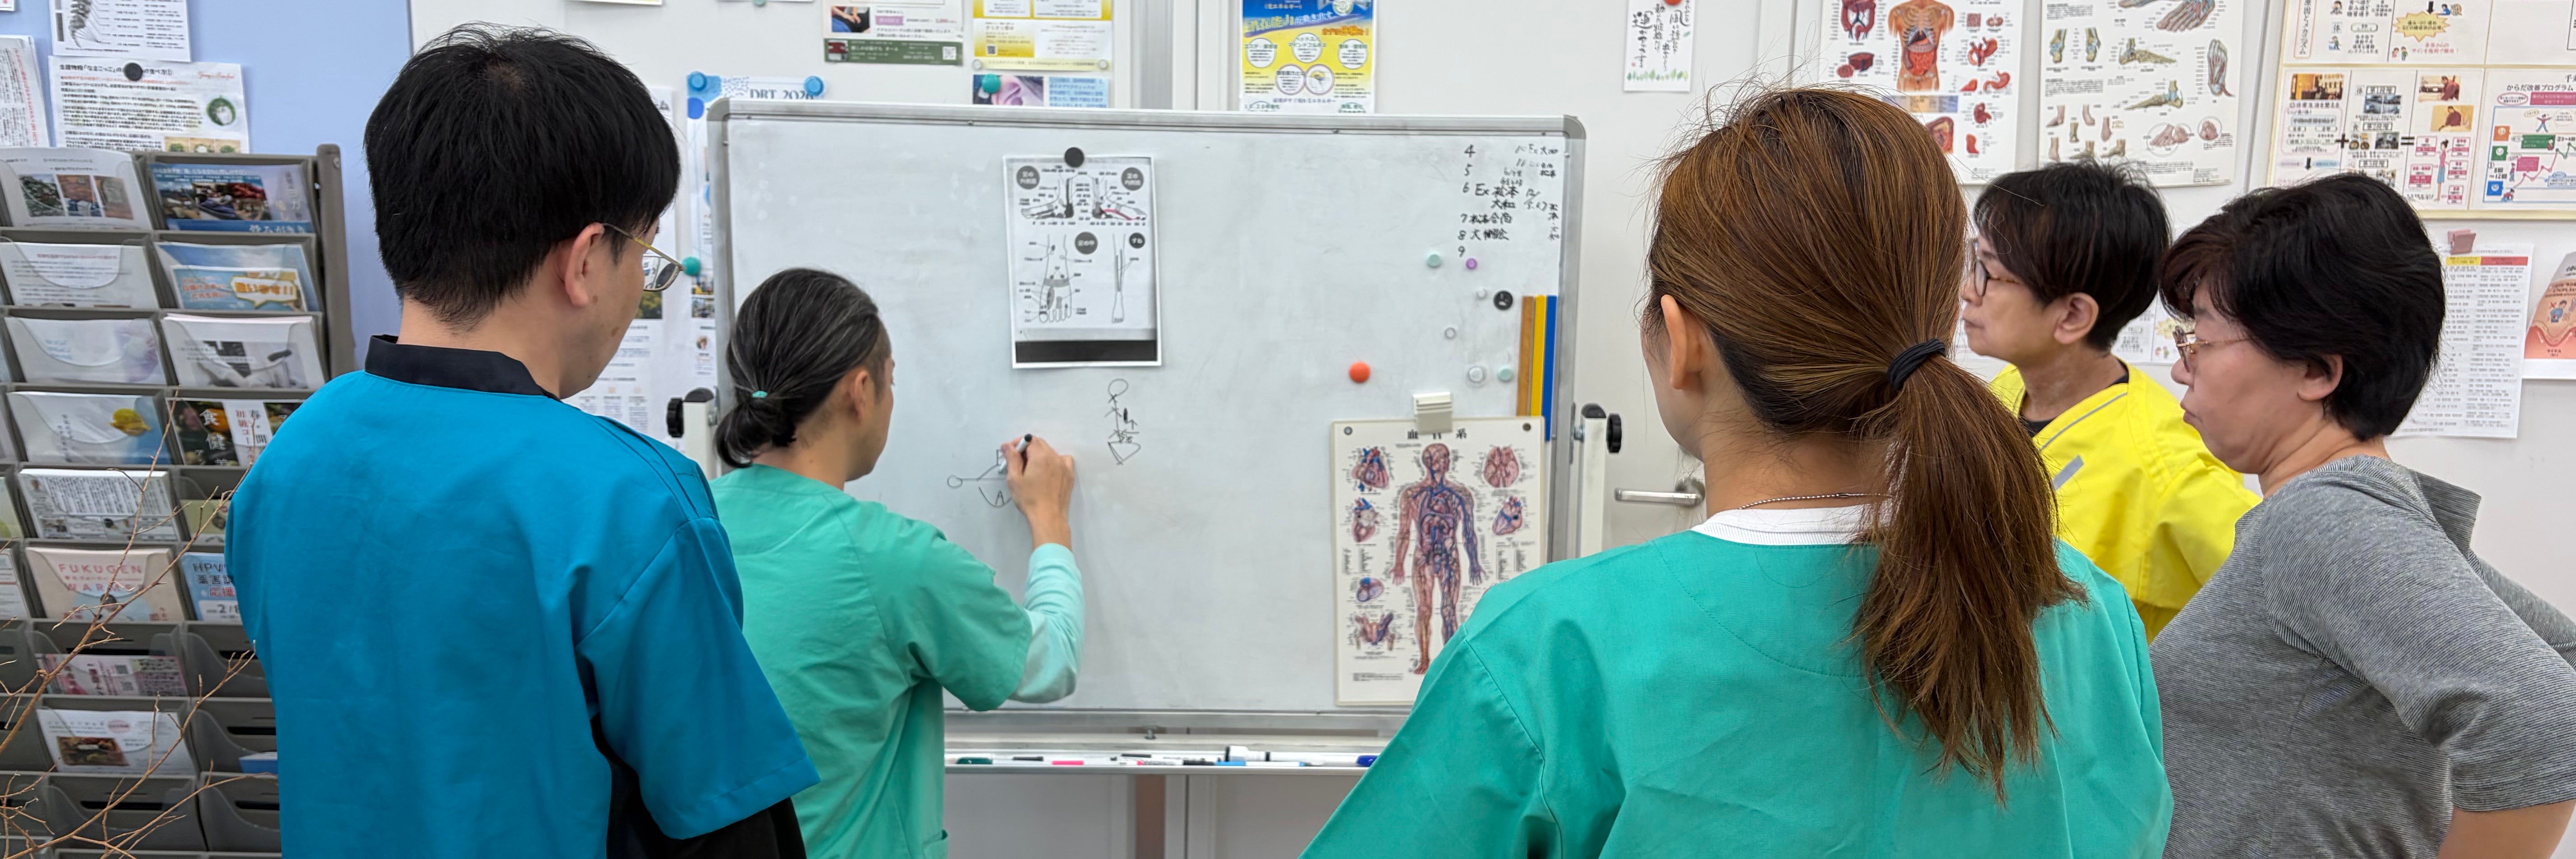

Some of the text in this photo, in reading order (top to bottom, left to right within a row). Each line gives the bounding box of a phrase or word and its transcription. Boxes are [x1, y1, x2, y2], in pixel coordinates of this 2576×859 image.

[1464, 144, 1476, 158] 4
[1464, 163, 1473, 176] 5
[1463, 182, 1470, 194] 6
[1460, 213, 1467, 223] 7
[1458, 230, 1466, 240] 8
[1458, 245, 1466, 258] 9
[58, 563, 142, 574] FUKUGEN
